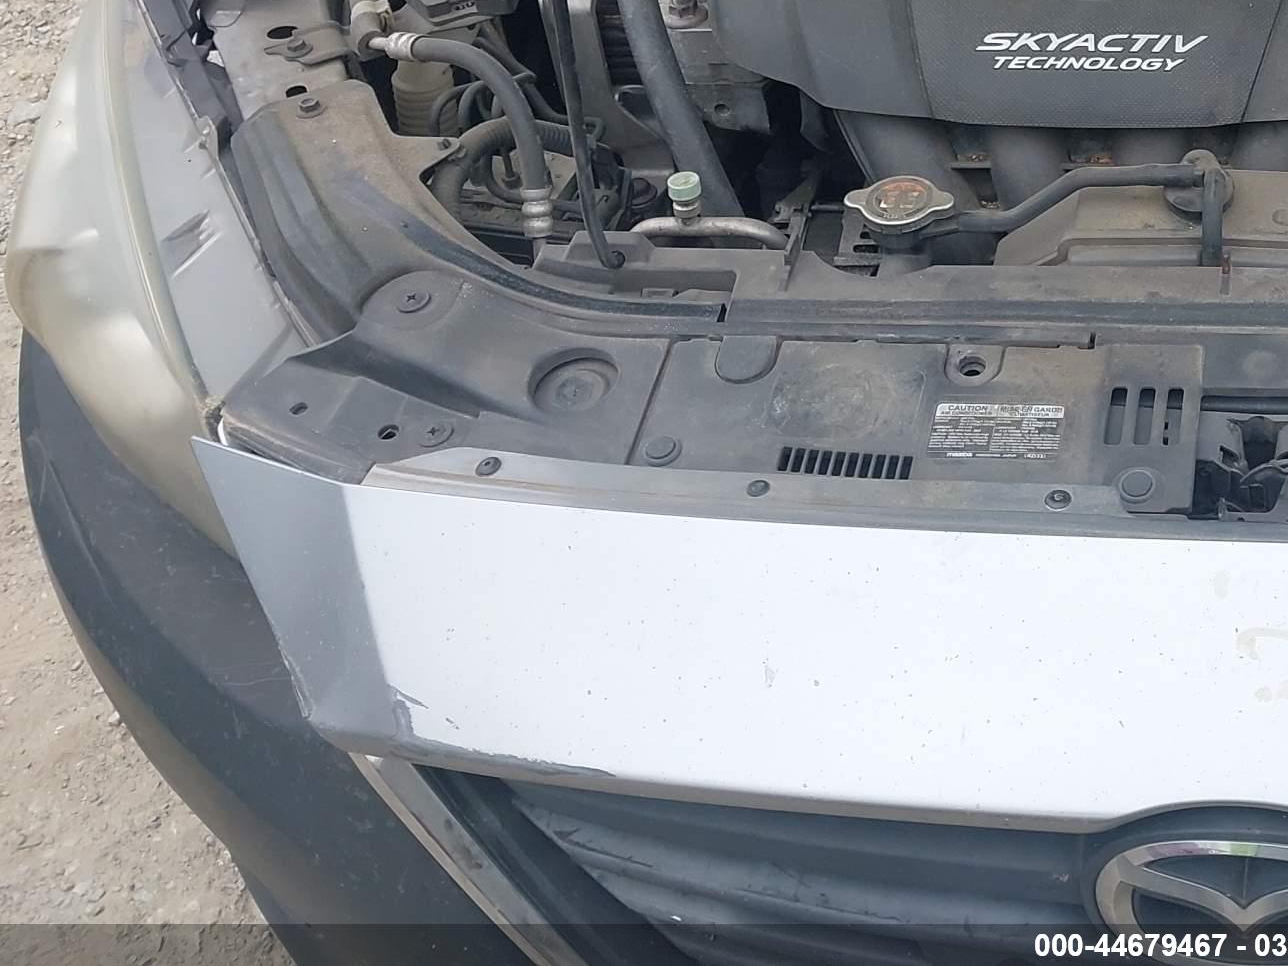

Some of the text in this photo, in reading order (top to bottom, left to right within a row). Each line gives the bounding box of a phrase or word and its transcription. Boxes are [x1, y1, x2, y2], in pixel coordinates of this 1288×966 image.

[975, 32, 1209, 53] SKYACTIV
[993, 55, 1185, 71] TECHNOLOGY
[947, 404, 988, 412] CAUTION
